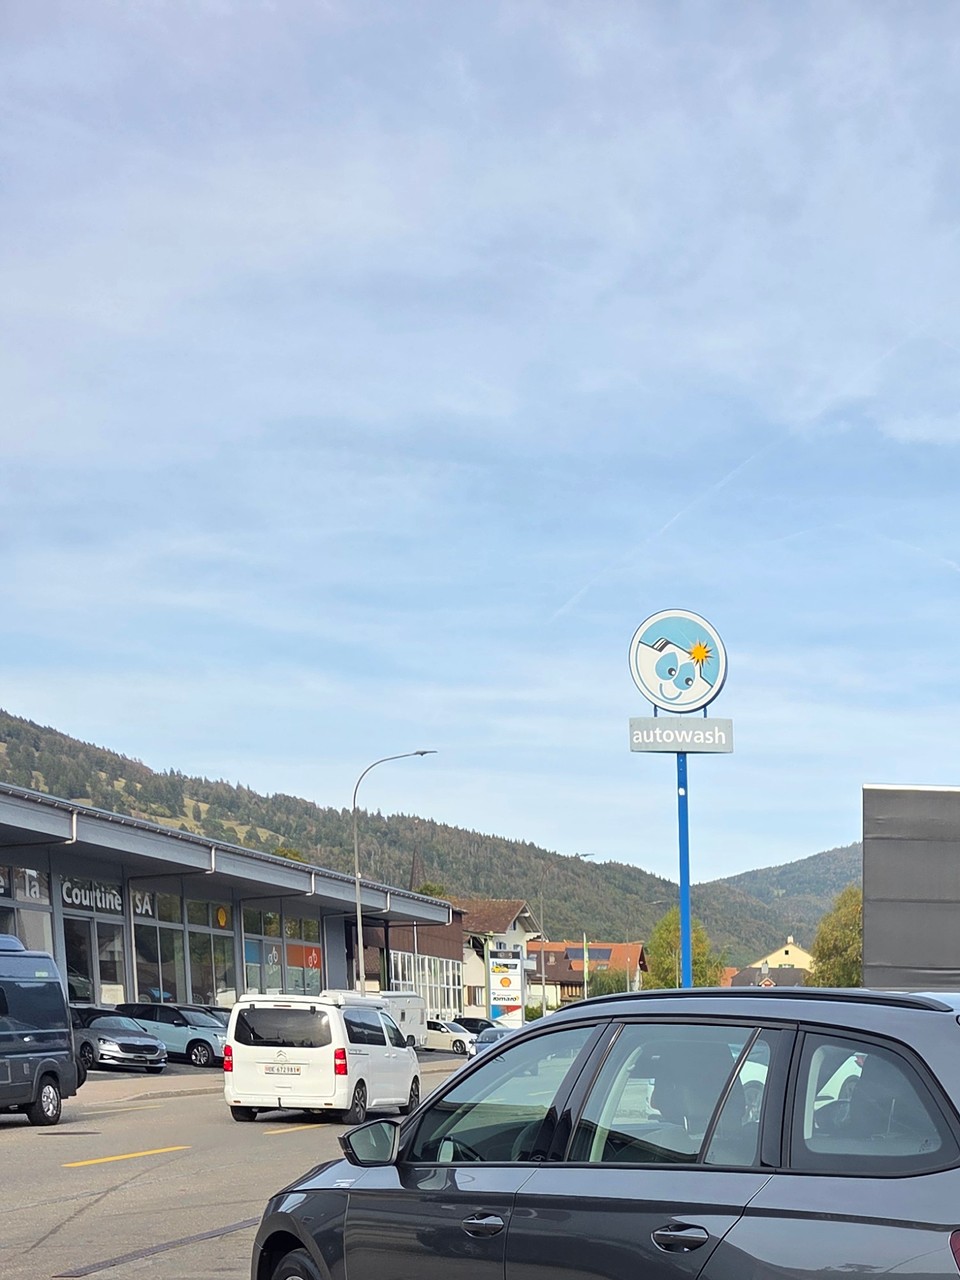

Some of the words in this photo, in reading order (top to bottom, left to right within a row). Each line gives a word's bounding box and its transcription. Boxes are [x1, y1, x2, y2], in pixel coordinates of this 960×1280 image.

[632, 726, 726, 745] autowash
[25, 873, 40, 899] la
[62, 881, 122, 911] Courtine
[136, 893, 152, 915] SA
